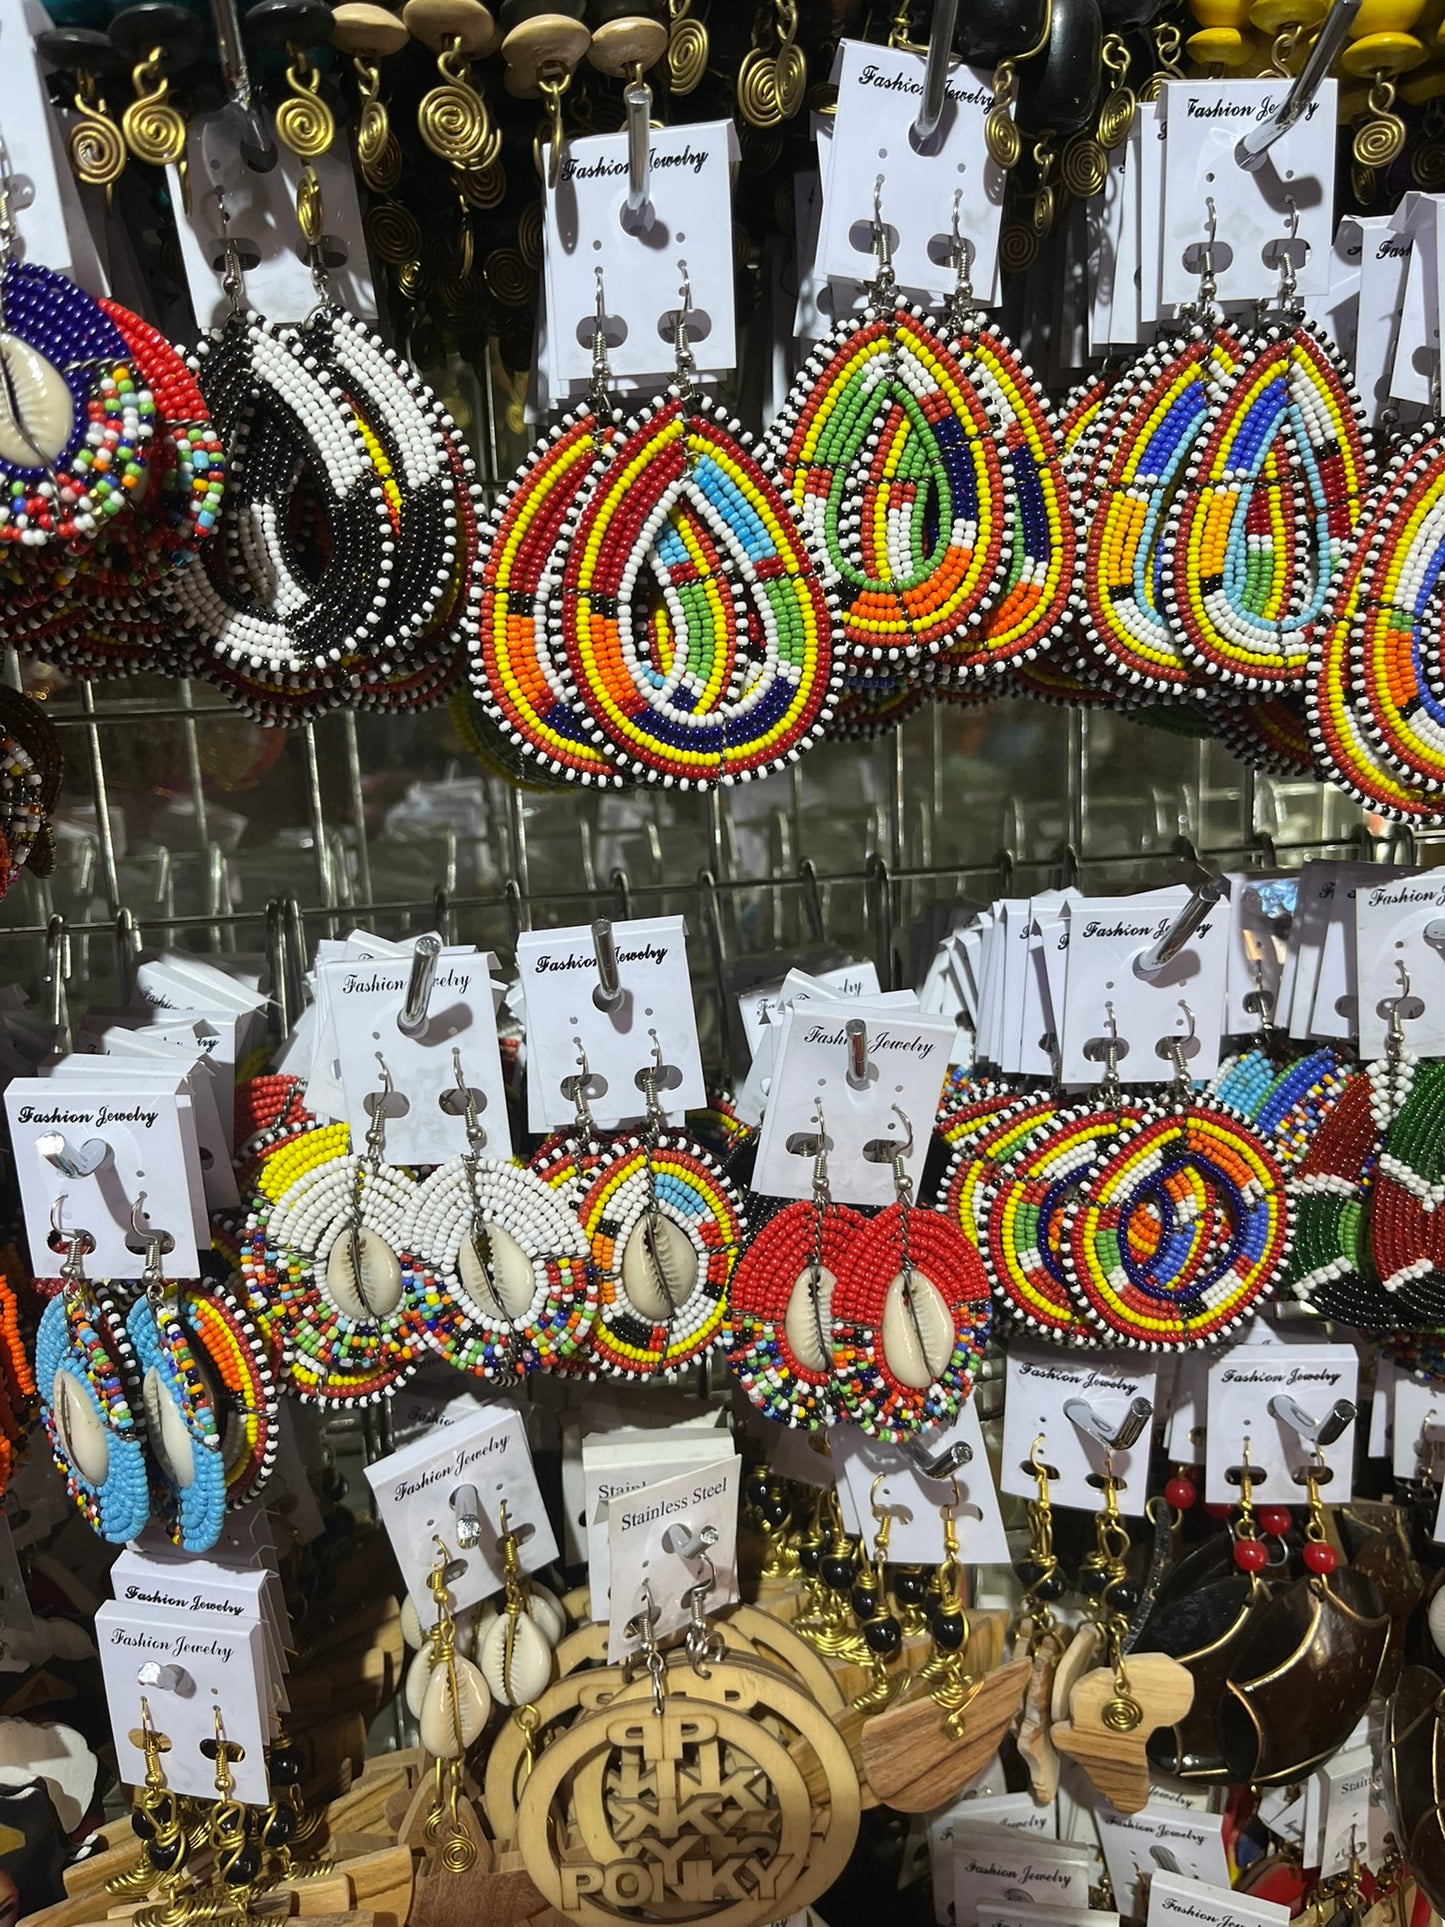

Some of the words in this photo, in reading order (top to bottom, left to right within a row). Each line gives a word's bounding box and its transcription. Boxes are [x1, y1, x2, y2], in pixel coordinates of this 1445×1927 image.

[1368, 887, 1437, 908] Fashion
[1082, 920, 1152, 939] Fashion
[868, 1031, 936, 1060] Jewelry
[18, 1105, 94, 1124] Fashion
[95, 1104, 160, 1128] Jewelry
[1019, 1361, 1083, 1384] Fashion
[1083, 1371, 1138, 1396] Jewelry
[1221, 1368, 1285, 1384] Fashion
[1286, 1367, 1341, 1386] Jewelry
[394, 1465, 454, 1503] Fashion
[454, 1433, 511, 1477] Jewelry
[621, 1495, 688, 1532] Stainless
[692, 1476, 727, 1505] Steel
[124, 1585, 189, 1609] Fashion
[190, 1594, 245, 1616] Jewelry
[111, 1628, 172, 1652] Fashion
[172, 1635, 234, 1663] Jewelry
[1156, 1824, 1207, 1846] Jewelry
[965, 1859, 1018, 1880] Fashion
[1018, 1865, 1072, 1888] Jewelry
[1162, 1897, 1218, 1923] Fashion
